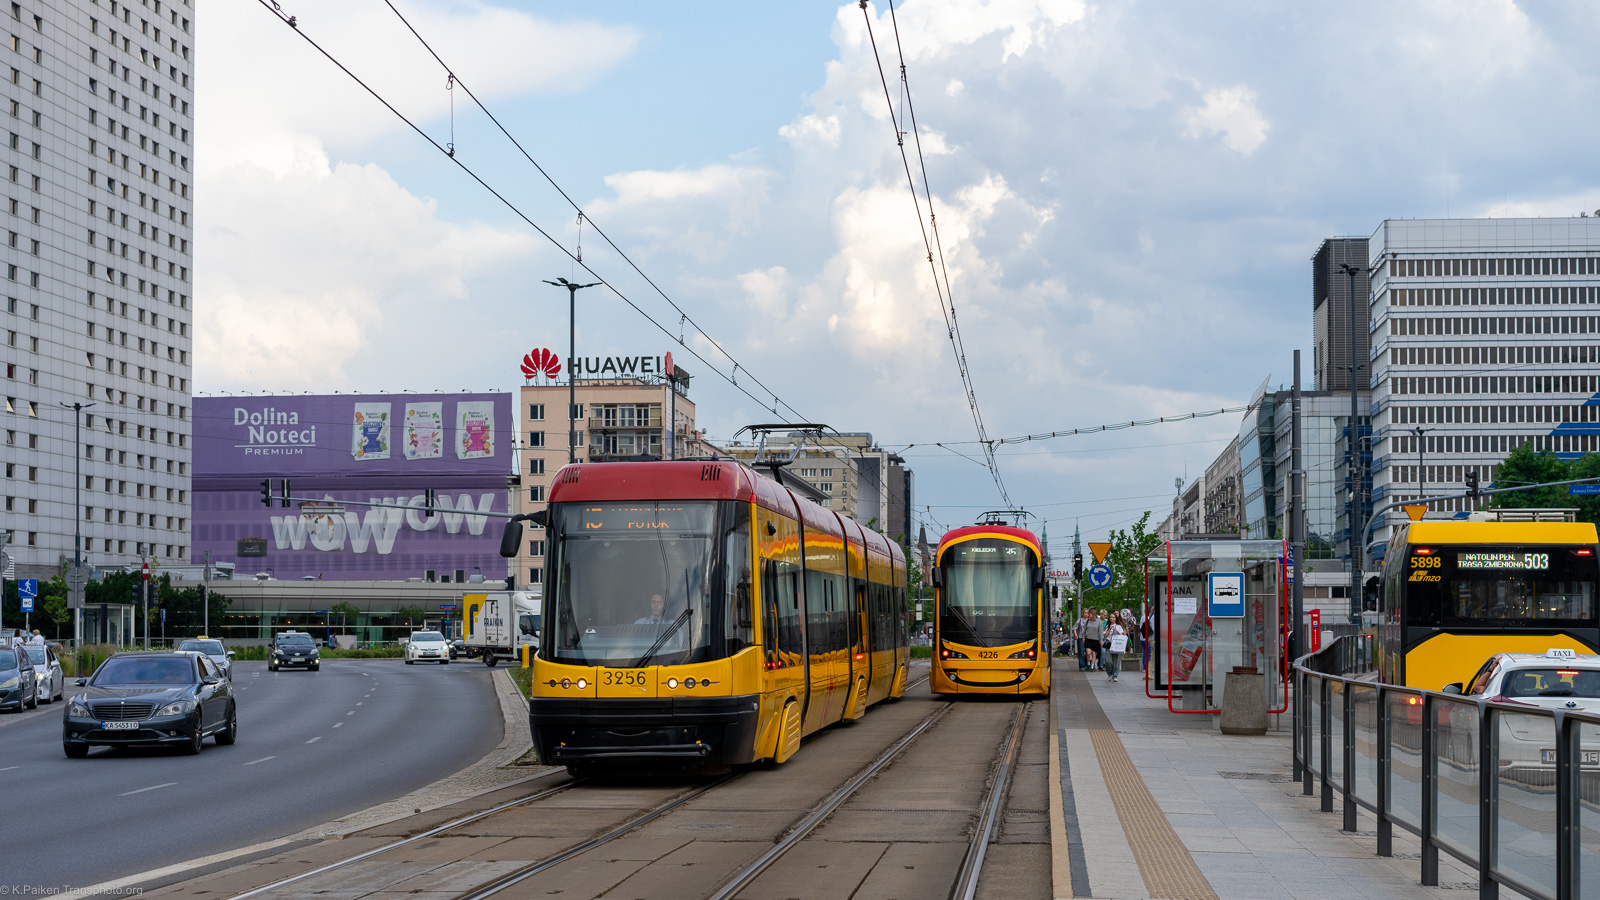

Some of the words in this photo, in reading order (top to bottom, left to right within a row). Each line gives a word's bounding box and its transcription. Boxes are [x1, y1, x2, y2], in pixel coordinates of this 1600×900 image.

[568, 356, 660, 373] HUAWEI
[234, 407, 299, 426] Dolina
[248, 425, 316, 444] Noteci
[369, 493, 495, 536] WOW
[270, 510, 401, 554] WOW
[1410, 557, 1441, 568] 5898
[1524, 553, 1549, 569] 503
[978, 651, 998, 659] 4226
[603, 671, 647, 686] 3256
